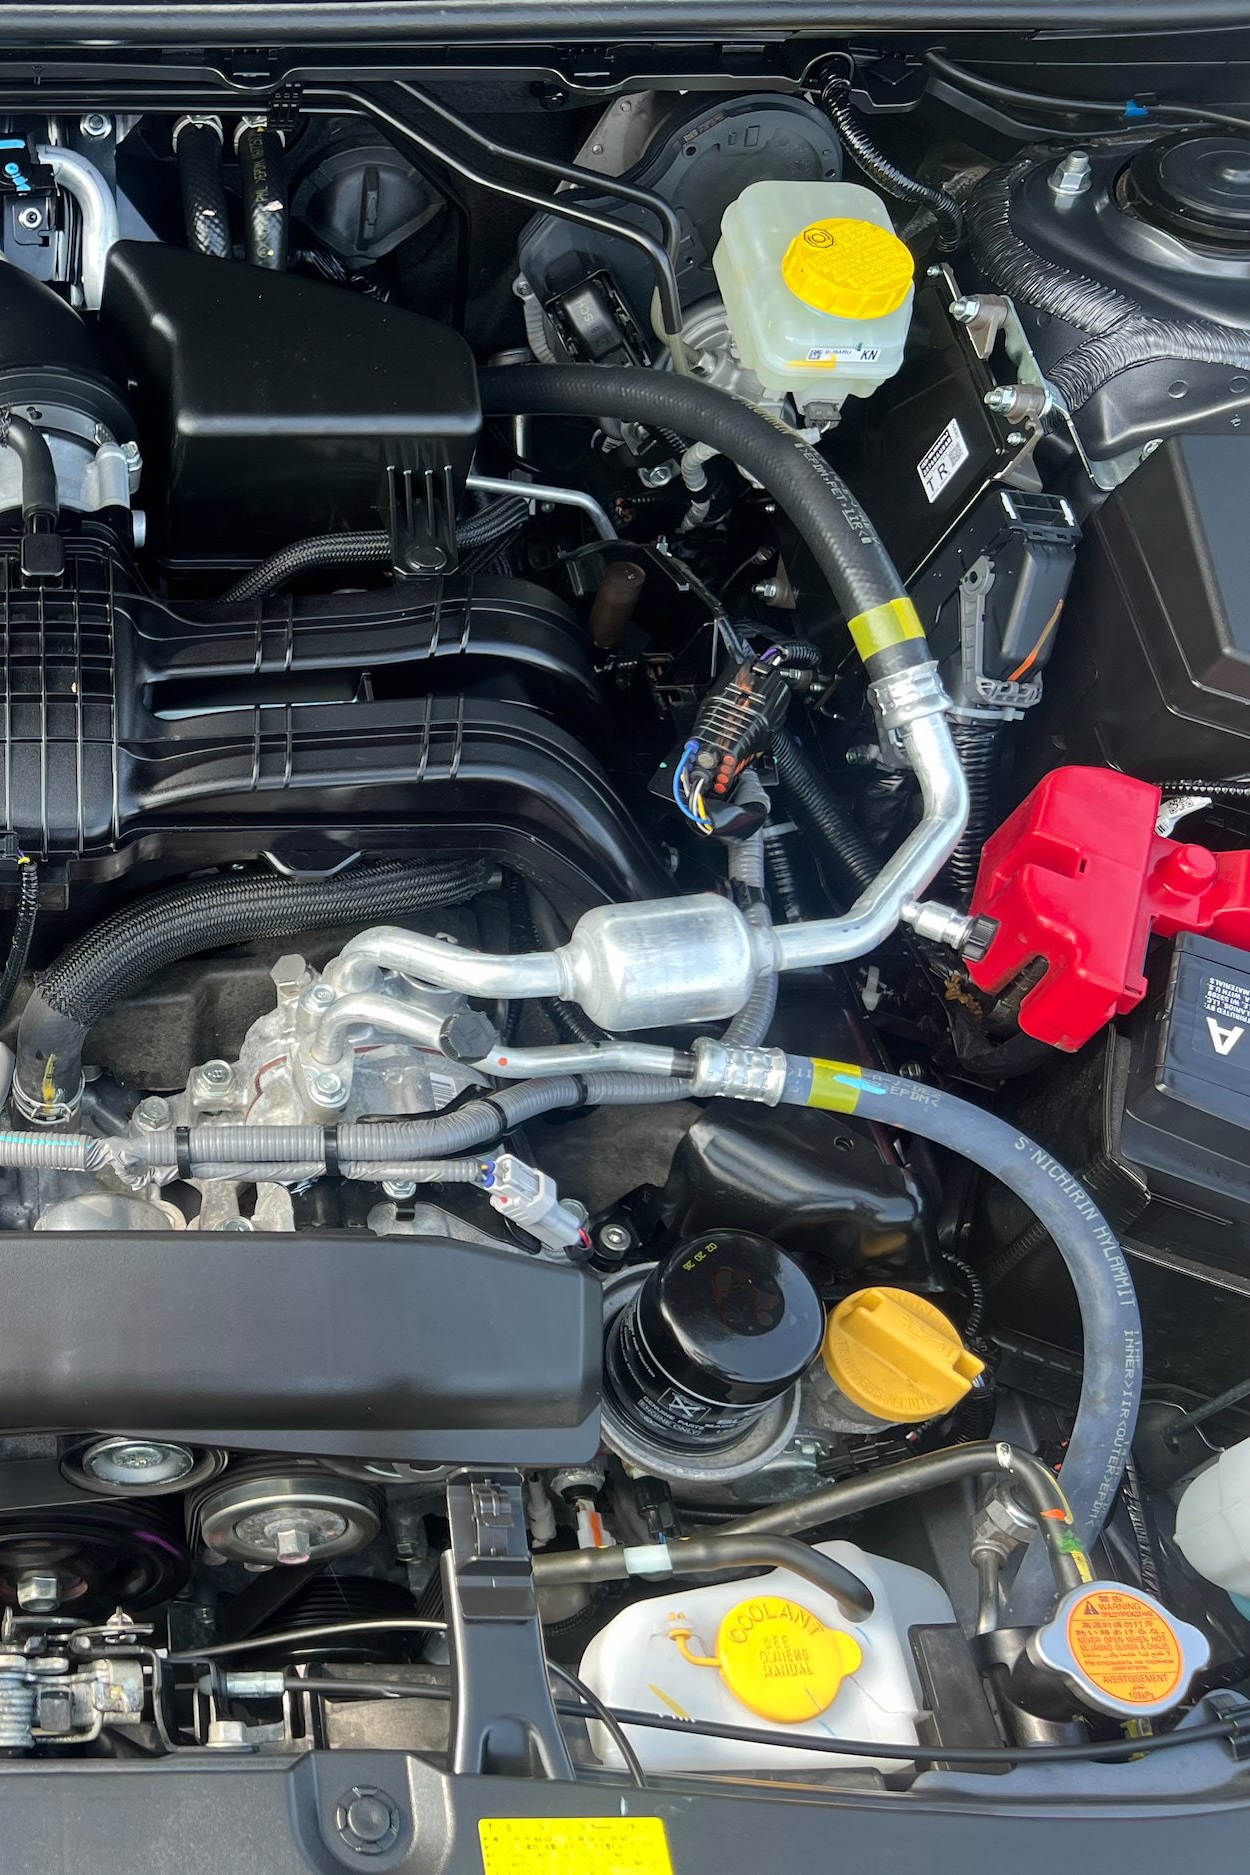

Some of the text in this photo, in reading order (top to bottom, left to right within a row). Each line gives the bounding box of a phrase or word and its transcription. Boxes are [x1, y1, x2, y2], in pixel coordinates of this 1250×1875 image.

[860, 350, 878, 361] KN
[1210, 977, 1250, 996] MATERIALS
[1222, 989, 1242, 1000] WITH
[1206, 1017, 1245, 1056] A
[1093, 1226, 1135, 1307] HYLAMMIT
[886, 1395, 934, 1411] MANUAL
[643, 1396, 705, 1431] GENUINE PARTS
[727, 1602, 824, 1643] COOLANT
[763, 1635, 789, 1649] SEE
[1077, 1636, 1100, 1644] NEVER
[1125, 1635, 1149, 1643] WHEN
[763, 1662, 813, 1678] MANUAL
[1103, 1674, 1168, 1684] AVERTISSEMENT
